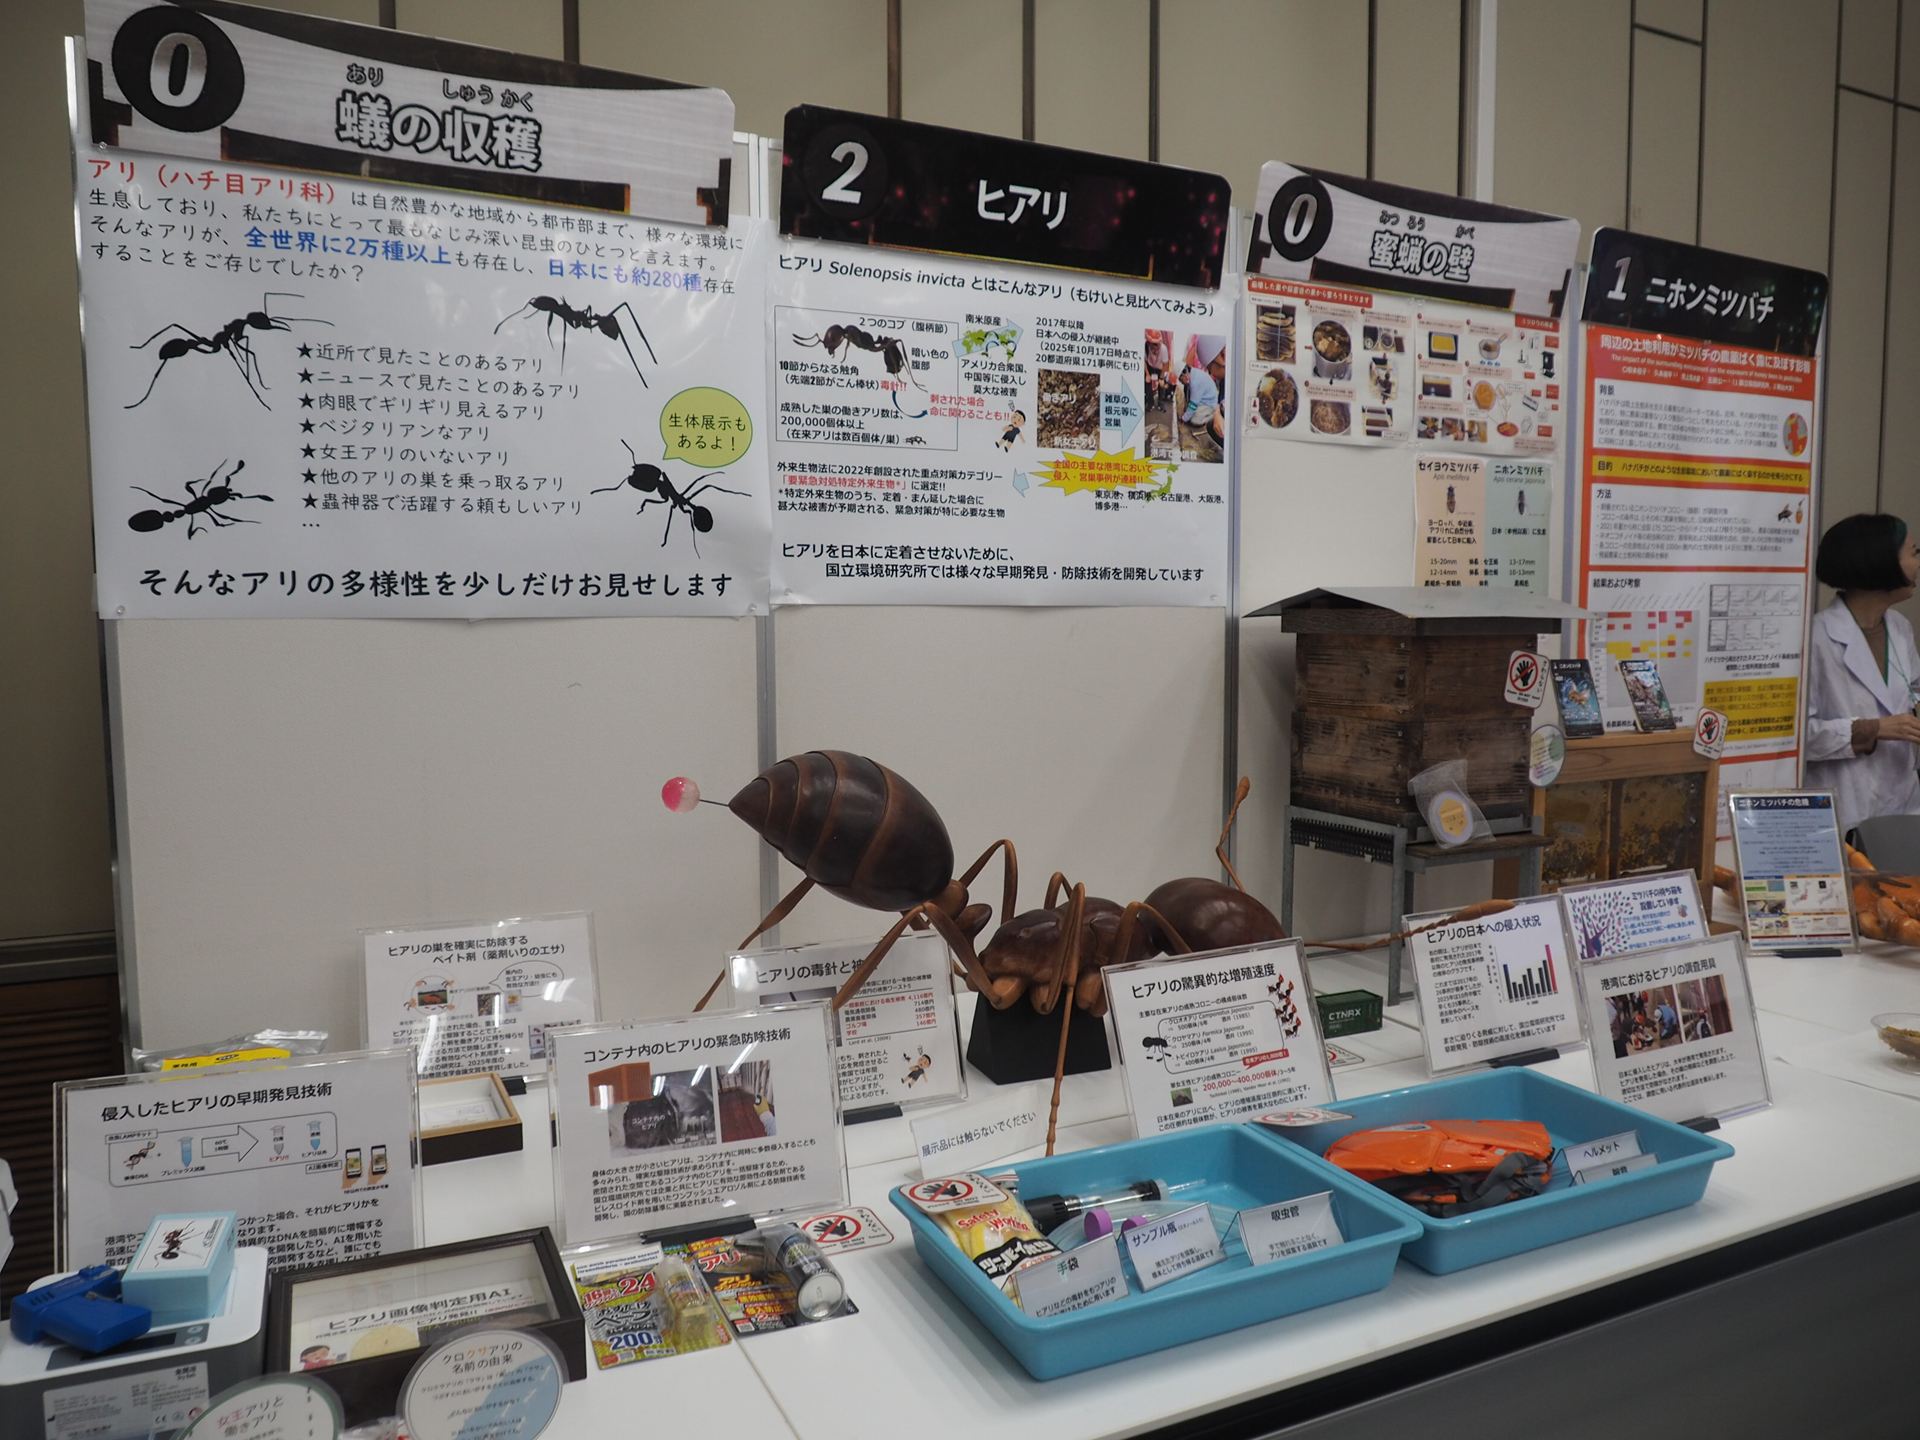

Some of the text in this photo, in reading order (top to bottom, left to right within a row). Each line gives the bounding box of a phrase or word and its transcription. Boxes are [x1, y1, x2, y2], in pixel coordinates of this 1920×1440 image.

[150, 31, 208, 107] 0
[347, 63, 384, 87] あり
[335, 92, 542, 171] 蟻の収穫
[821, 140, 869, 204] 2
[977, 179, 1068, 230] ヒアリ
[1283, 193, 1318, 245] 0
[89, 189, 716, 271] 生息しており、私たちにとって最もなじみ深い昆虫のひとつと言えます。
[91, 215, 735, 295] そんなアリが、全世界に2万種以上も存在し、日本にも約280種存在
[91, 242, 364, 281] することをご存じでしたか？
[779, 254, 1215, 318] ヒアリ Solenopsis invicta とはこんなアリ（もけいと見比べてみよう）
[1607, 256, 1632, 301] 1
[1646, 277, 1775, 323] ニホンミツバチ
[965, 313, 1001, 327] 南米原産
[1036, 316, 1085, 330] 2017年以降
[1036, 328, 1120, 345] 日本への侵入が継続中
[911, 347, 949, 360] 暗い色の
[779, 360, 859, 376] 10節からなる触角
[911, 360, 931, 371] 腹部
[964, 371, 1027, 386] 中国等に侵入し
[930, 394, 985, 407] 刺された場合
[973, 384, 1018, 398] 莫大な被害
[1105, 393, 1130, 405] 雑草の
[780, 402, 904, 420] 成熟した巣の働きアリ数は、
[669, 412, 746, 432] 生体展示も
[781, 416, 864, 430] 200,000個体以上
[1105, 417, 1121, 428] 営巣
[678, 433, 735, 451] あるよ！
[1419, 462, 1480, 473] セイヨウミツバチ
[1495, 465, 1544, 476] ニホンミツバチ
[1598, 461, 1613, 471] 目的
[1597, 489, 1612, 499] 方法
[782, 543, 1015, 561] ヒアリを日本に定着させないために、
[826, 563, 1204, 581] 国立環境研究所では様々な早期発見・防除技術を開発しています
[139, 568, 733, 599] そんなアリの多様性を少しだけお見せします
[1427, 914, 1541, 944] ヒアリの日本への侵入状況
[388, 936, 528, 957] ヒアリの巣を確実に防除する
[756, 958, 877, 984] ヒアリの毒針と被
[1132, 963, 1276, 999] ヒアリの驚異的な増殖速度
[584, 1027, 791, 1064] コンテナ内のヒアリの緊急防除技術
[102, 1082, 332, 1122] 侵入したヒアリの早期発見技術
[922, 1111, 1036, 1157] 展示品には触らないでください
[1583, 1141, 1620, 1158] ヘルメット
[958, 1209, 999, 1229] Safety
[1271, 1205, 1301, 1222] 吸虫管
[1132, 1221, 1177, 1247] サンプル瓶
[699, 1250, 741, 1273] アリ
[1057, 1256, 1079, 1275] 手袋
[609, 1331, 654, 1351] 200
[452, 1353, 513, 1374] 名前の由来
